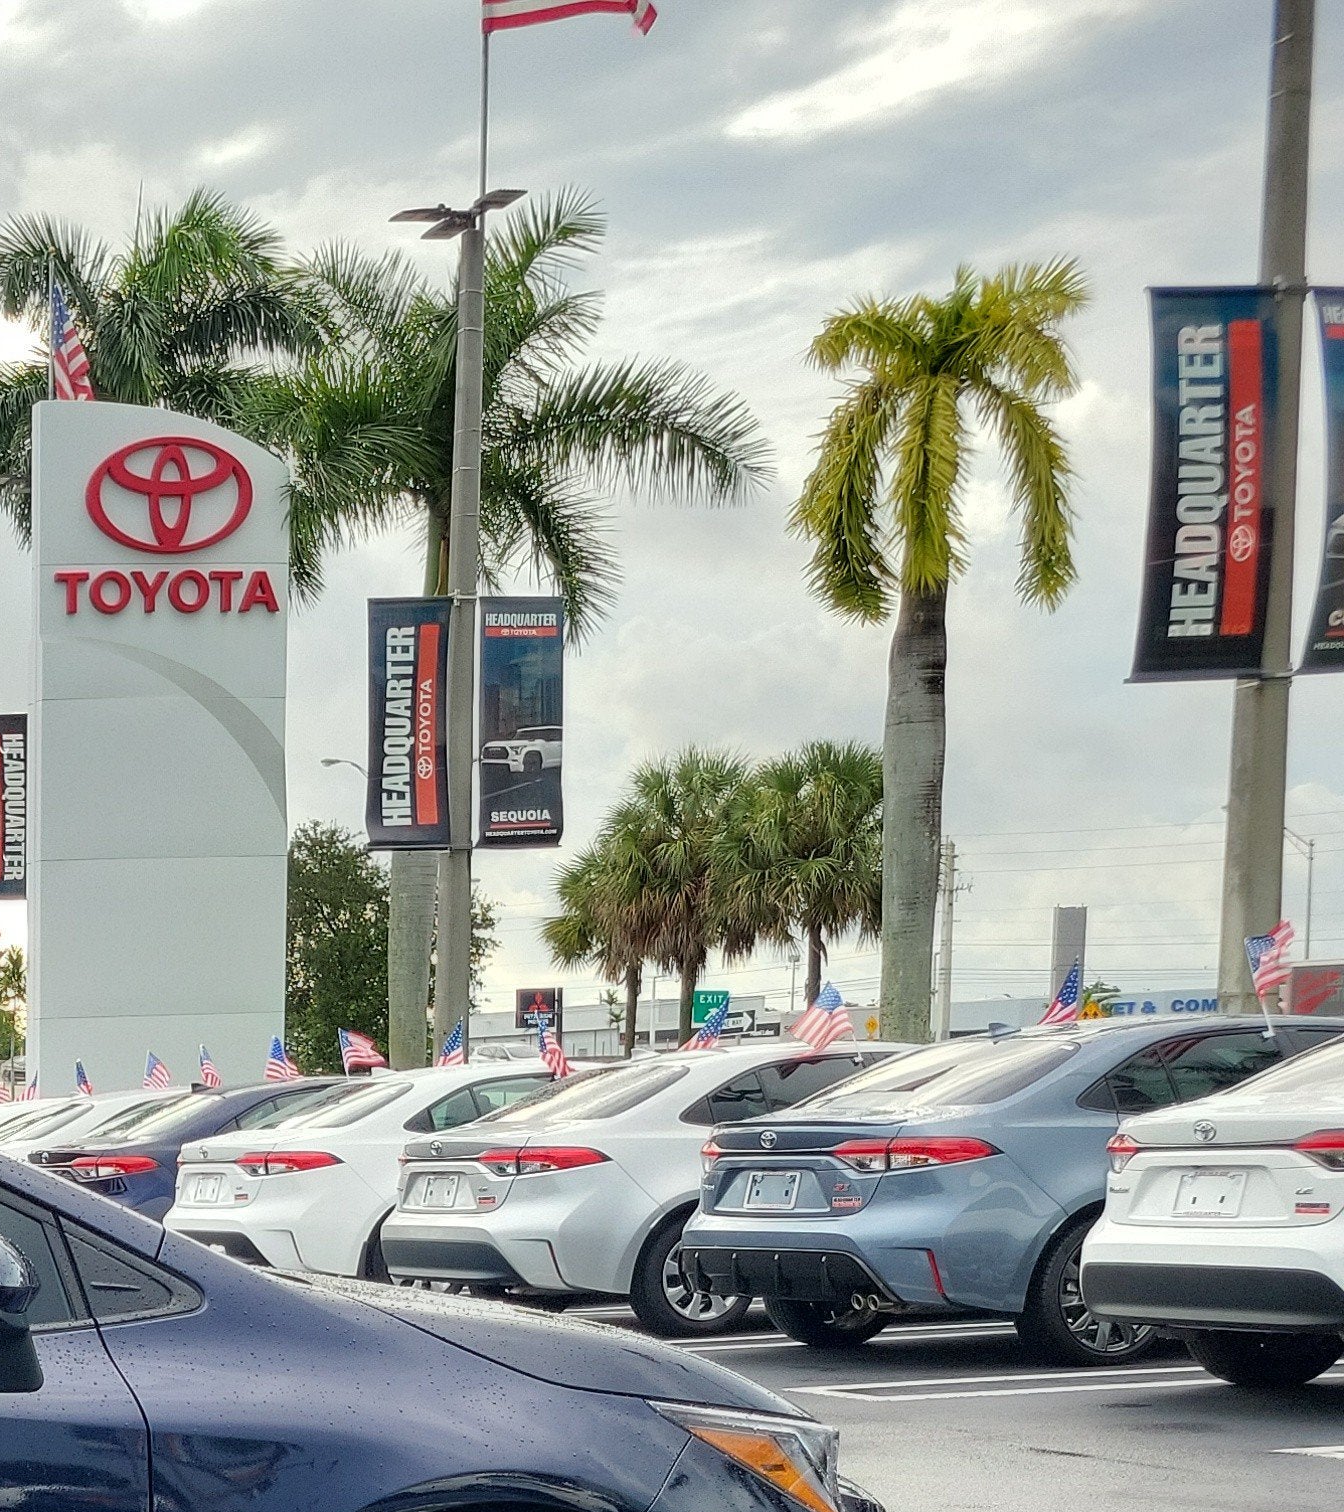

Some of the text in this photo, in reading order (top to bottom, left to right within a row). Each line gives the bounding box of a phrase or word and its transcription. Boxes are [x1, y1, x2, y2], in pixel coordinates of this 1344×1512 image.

[1167, 322, 1228, 637] HEADQUARTER
[1234, 404, 1256, 522] TOYOTA
[54, 569, 280, 615] TOYOTA
[485, 613, 557, 628] HEADQUARTER
[382, 626, 416, 826] HEADQUARTER
[417, 678, 433, 754] TOYOTA
[0, 733, 25, 881] HEADQUARTER
[490, 809, 551, 822] SEQUOIA
[699, 994, 724, 1004] EXIT
[1141, 1001, 1156, 1014] &
